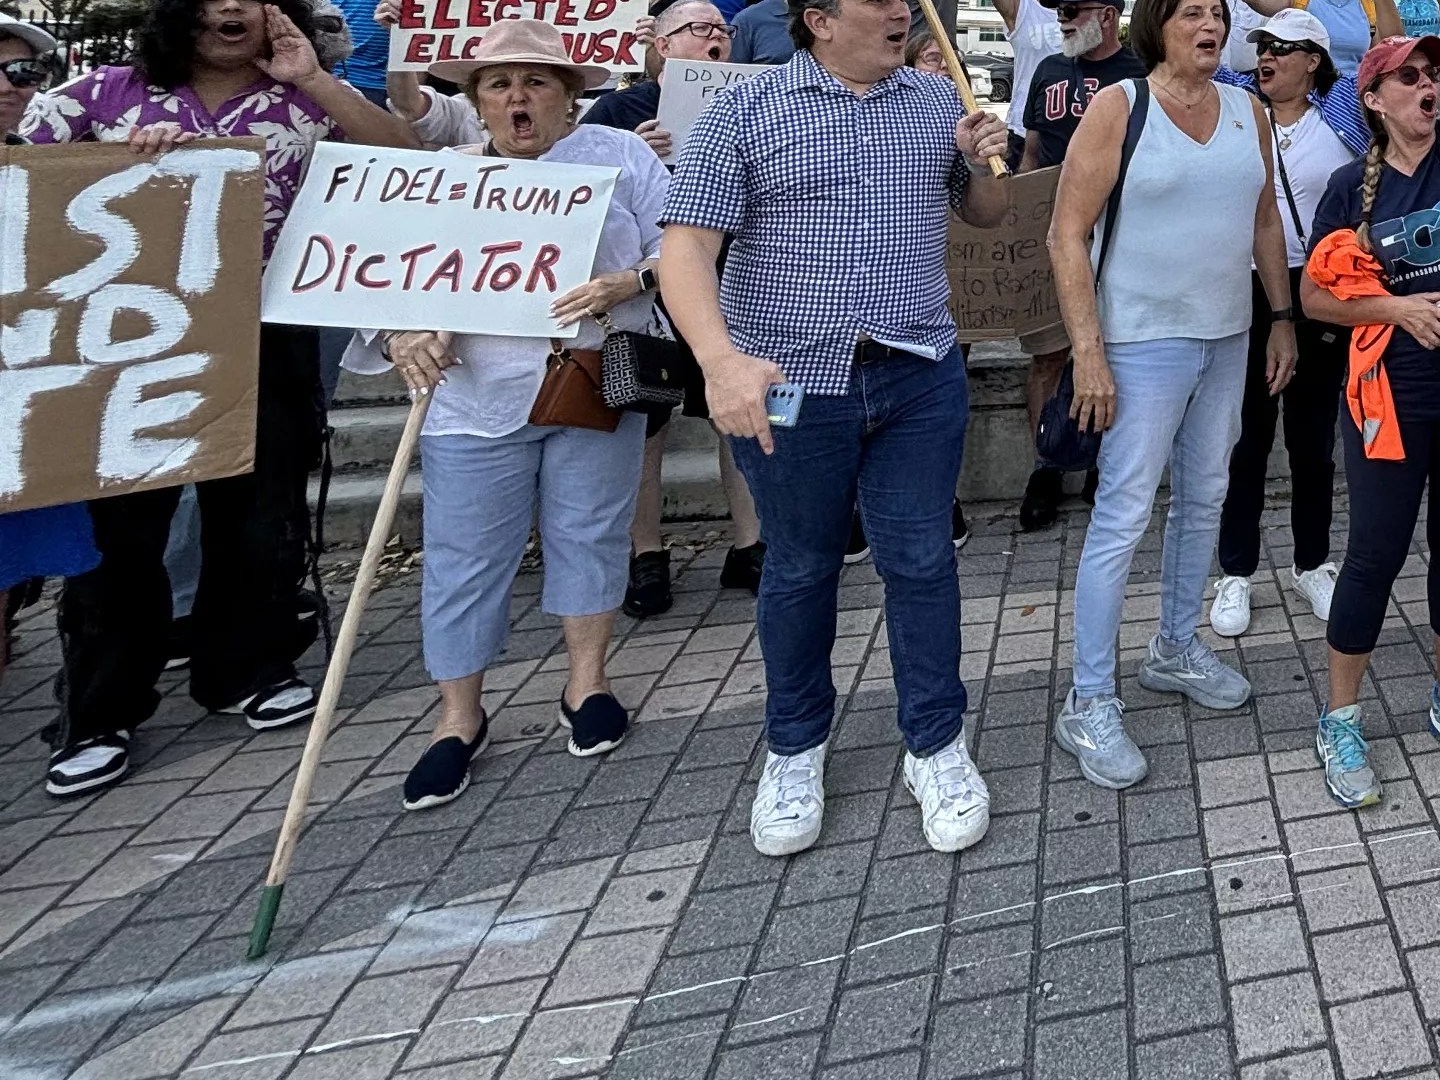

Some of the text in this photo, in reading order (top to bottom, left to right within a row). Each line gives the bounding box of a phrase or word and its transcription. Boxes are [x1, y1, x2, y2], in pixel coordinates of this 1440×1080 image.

[684, 68, 751, 85] DO YO
[991, 238, 1038, 264] are
[960, 266, 985, 297] to
